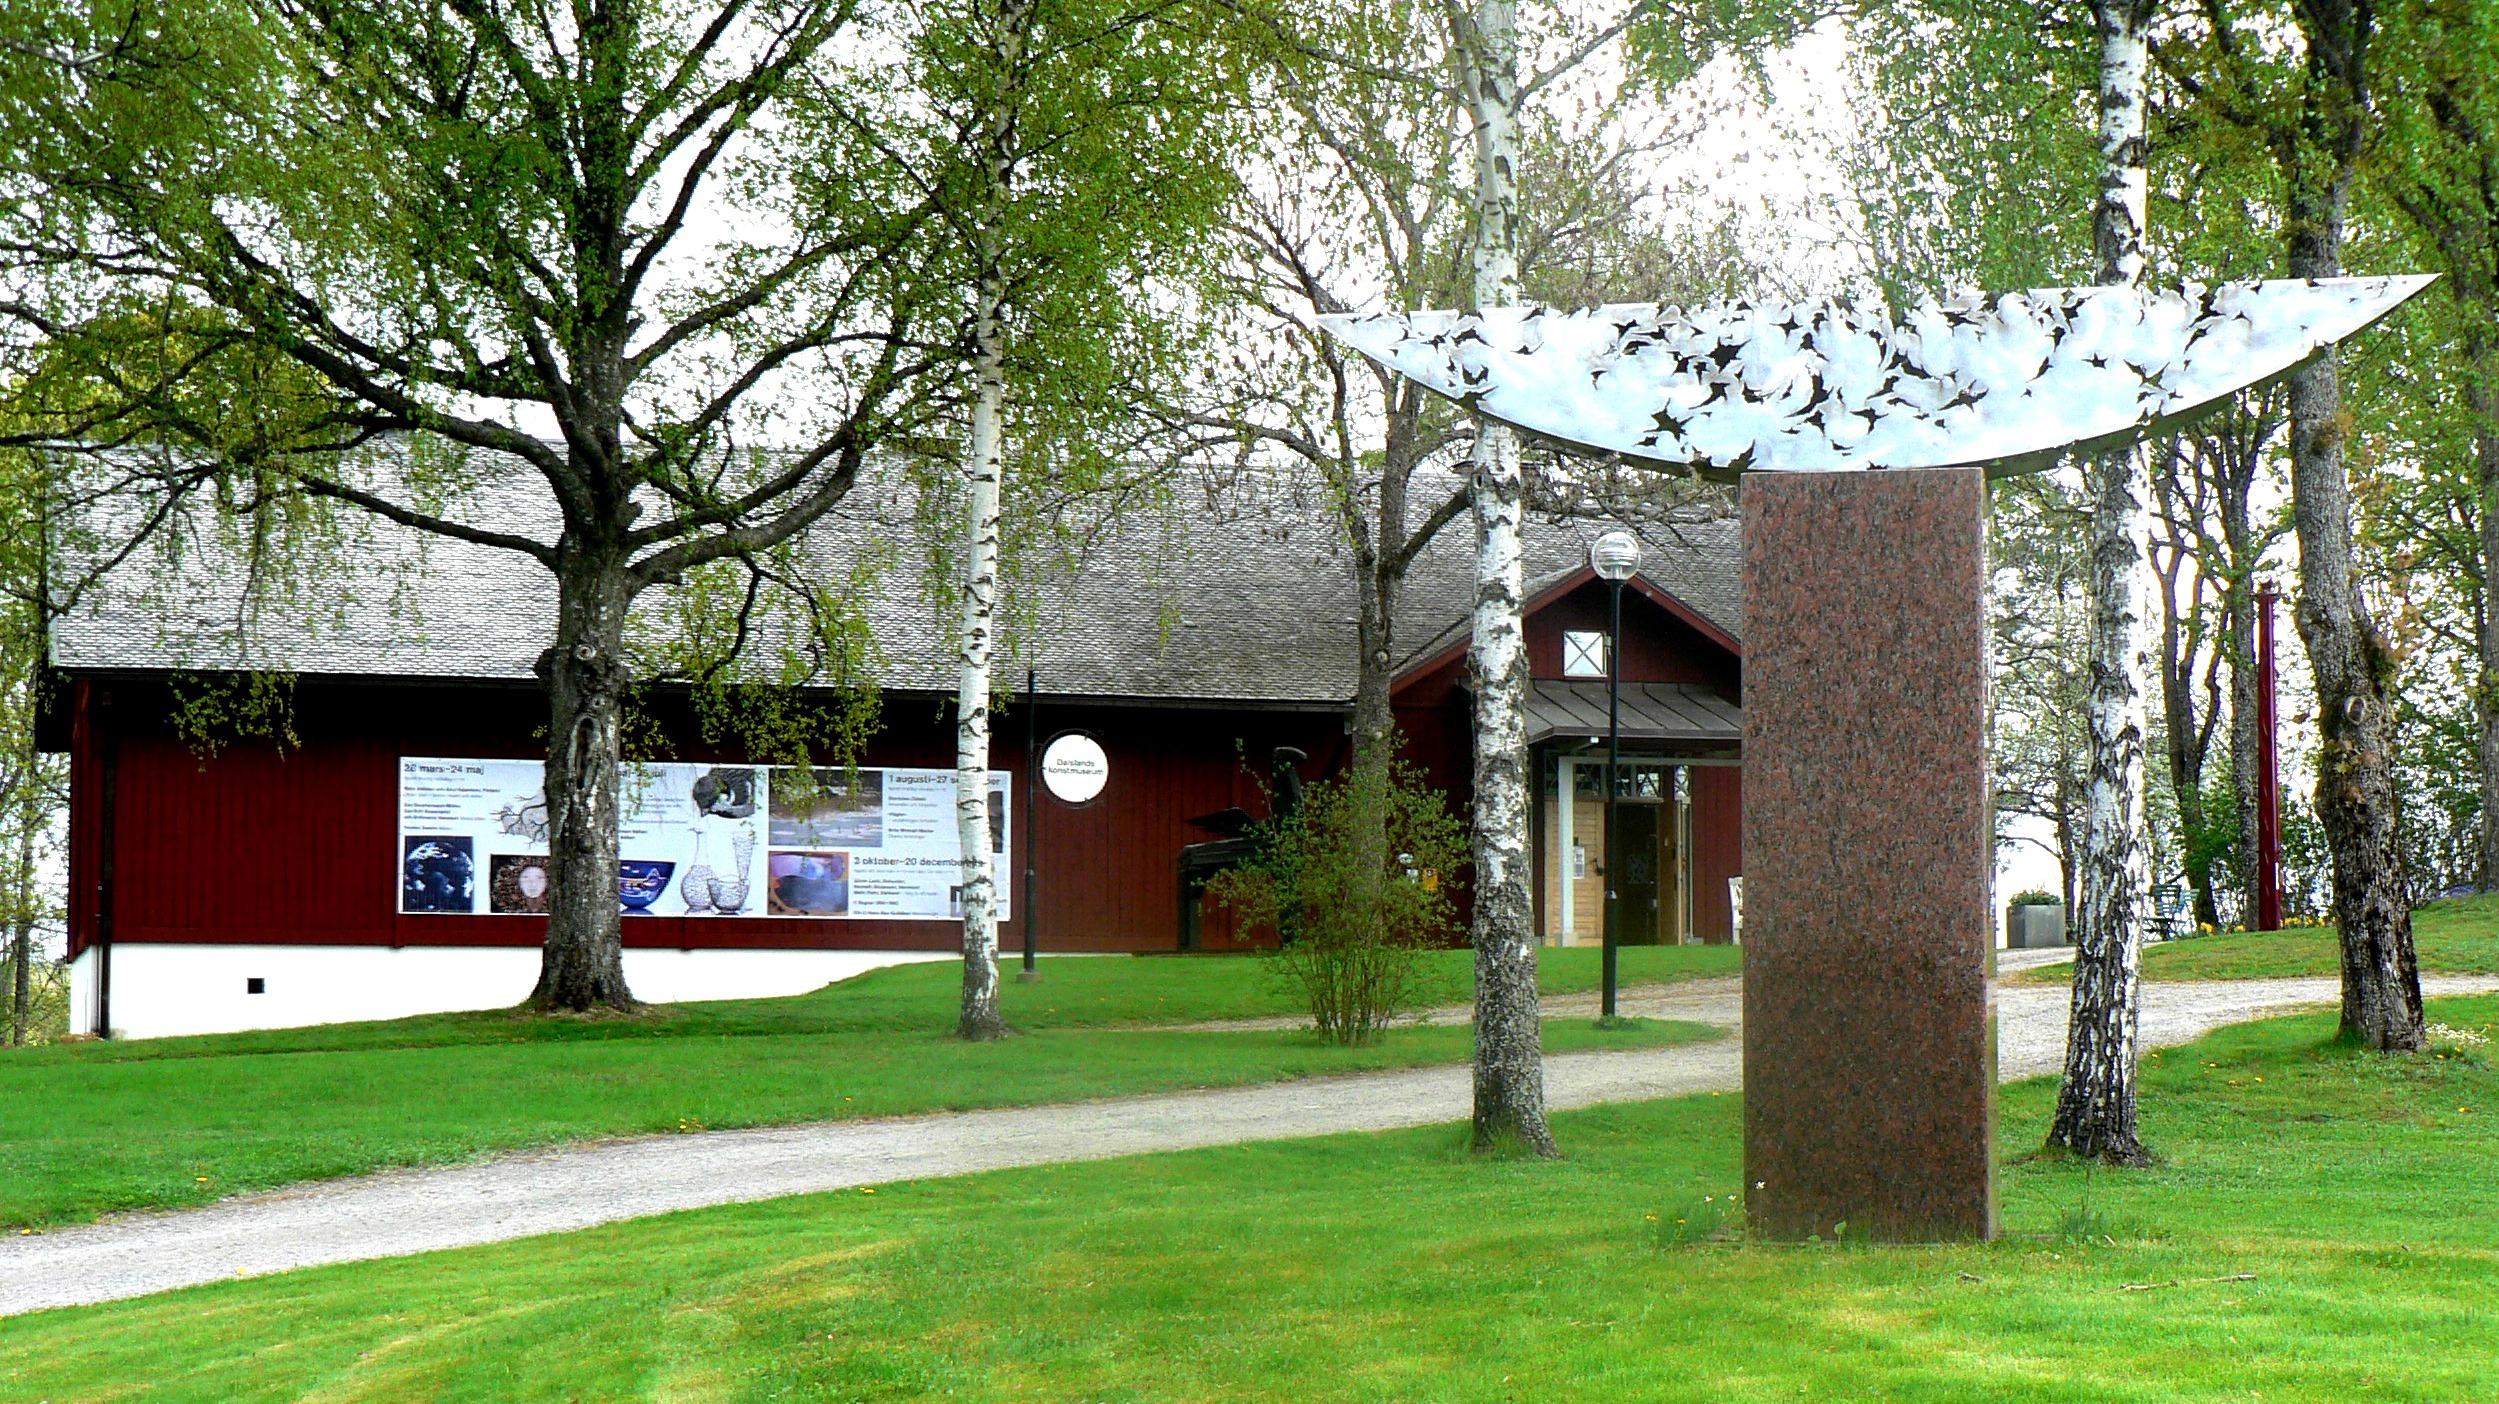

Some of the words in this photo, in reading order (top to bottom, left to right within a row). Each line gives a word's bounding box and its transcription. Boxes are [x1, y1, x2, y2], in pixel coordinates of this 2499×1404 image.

[1056, 758, 1095, 766] Dalslands
[466, 763, 485, 775] maj
[1048, 766, 1104, 774] konstmuseum
[920, 857, 964, 867] decembe
